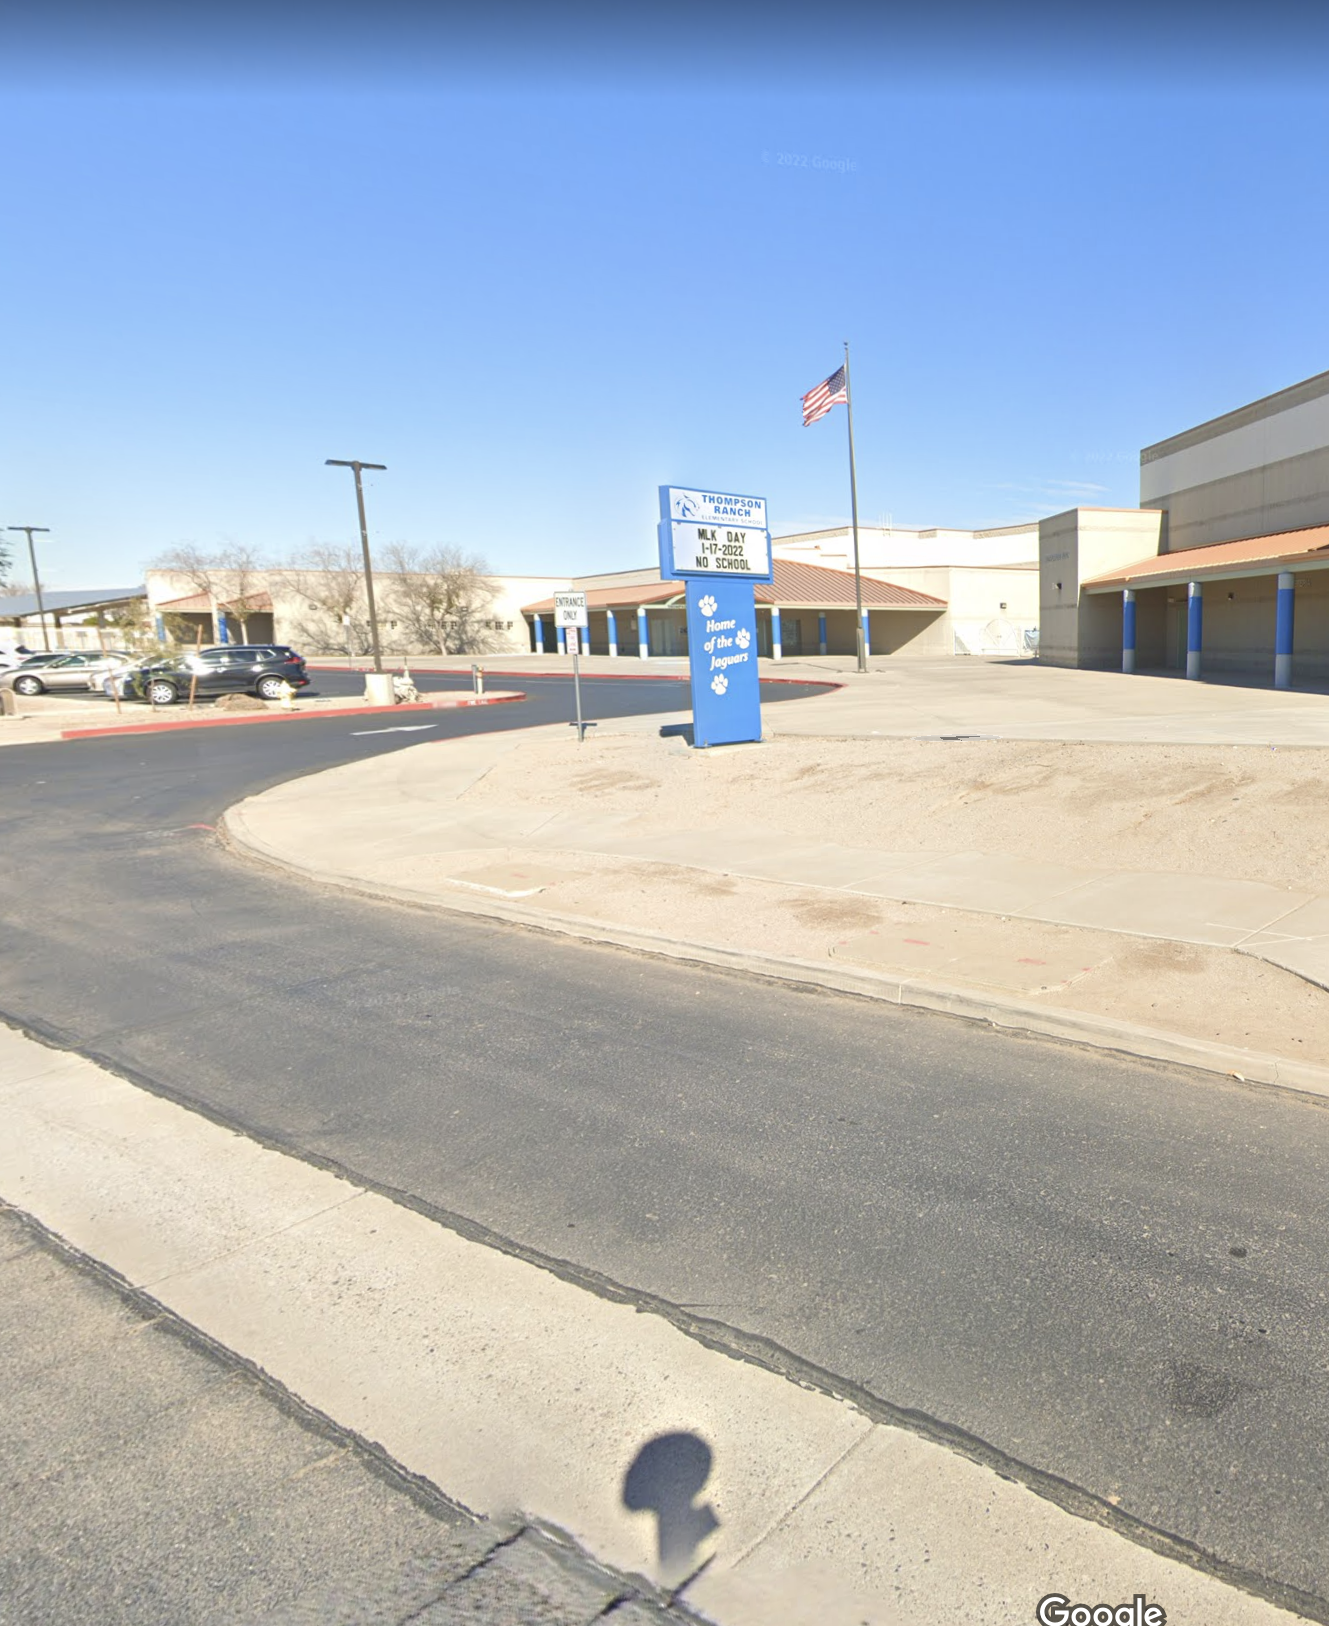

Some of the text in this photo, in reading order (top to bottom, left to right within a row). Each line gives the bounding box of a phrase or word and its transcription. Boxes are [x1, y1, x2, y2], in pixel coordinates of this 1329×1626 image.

[701, 494, 762, 509] THOMPSON
[714, 506, 751, 517] RANCH
[701, 515, 763, 526] ELEMENTARY SCHOOL
[698, 528, 746, 543] MLK DAY
[701, 543, 744, 557] 1-17-2022
[696, 556, 751, 571] NO SCHOOL
[555, 597, 584, 607] ENTRANCE
[563, 610, 577, 620] ONLY
[706, 618, 736, 633] Home
[704, 636, 733, 653] of the
[710, 654, 748, 671] Jaguars
